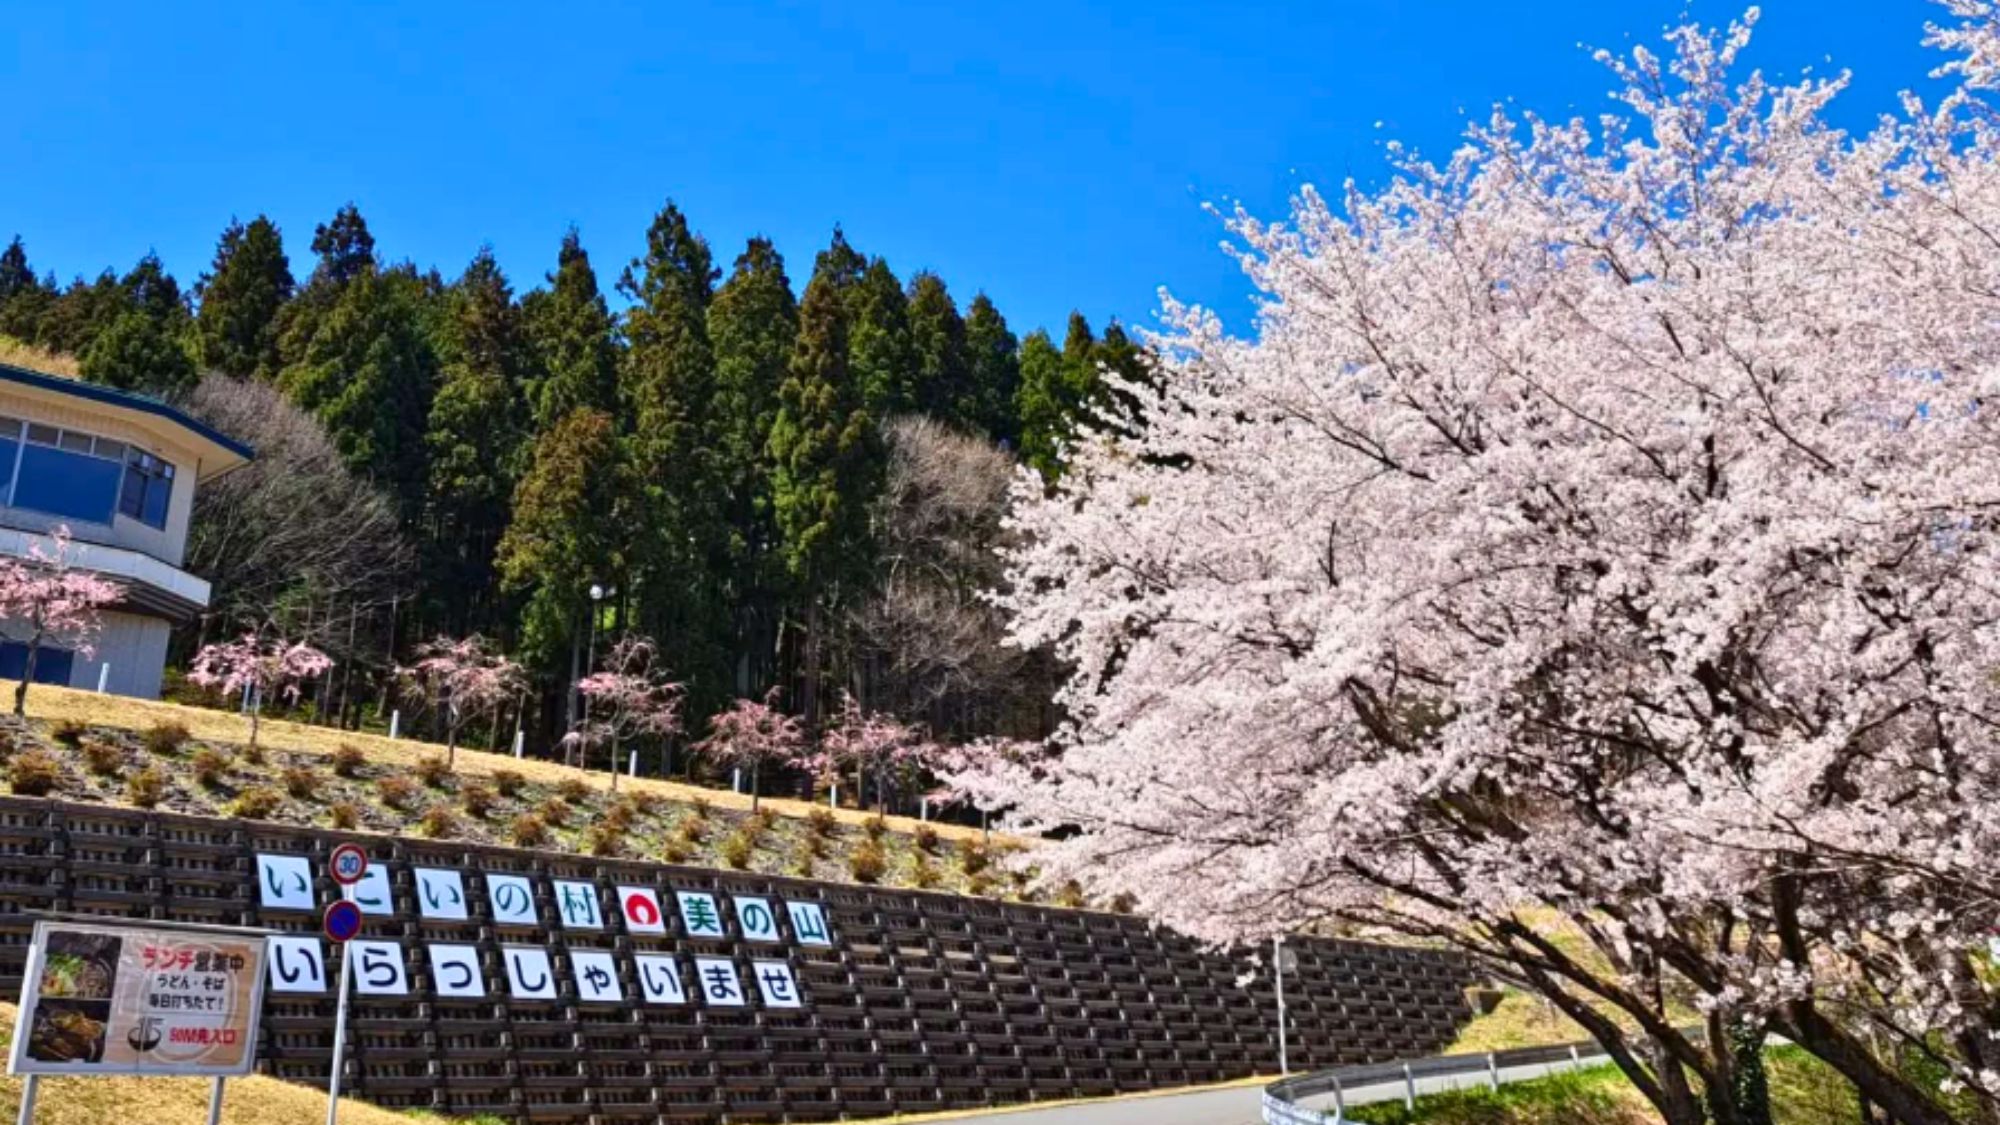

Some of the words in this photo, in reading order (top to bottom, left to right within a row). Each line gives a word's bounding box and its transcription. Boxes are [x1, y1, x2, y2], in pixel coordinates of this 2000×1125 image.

[339, 856, 358, 874] 30
[684, 897, 825, 940] 美の山
[143, 947, 244, 974] ランチ営業中
[277, 944, 792, 1001] いらっしゃいませ
[157, 975, 226, 990] うどん・そば
